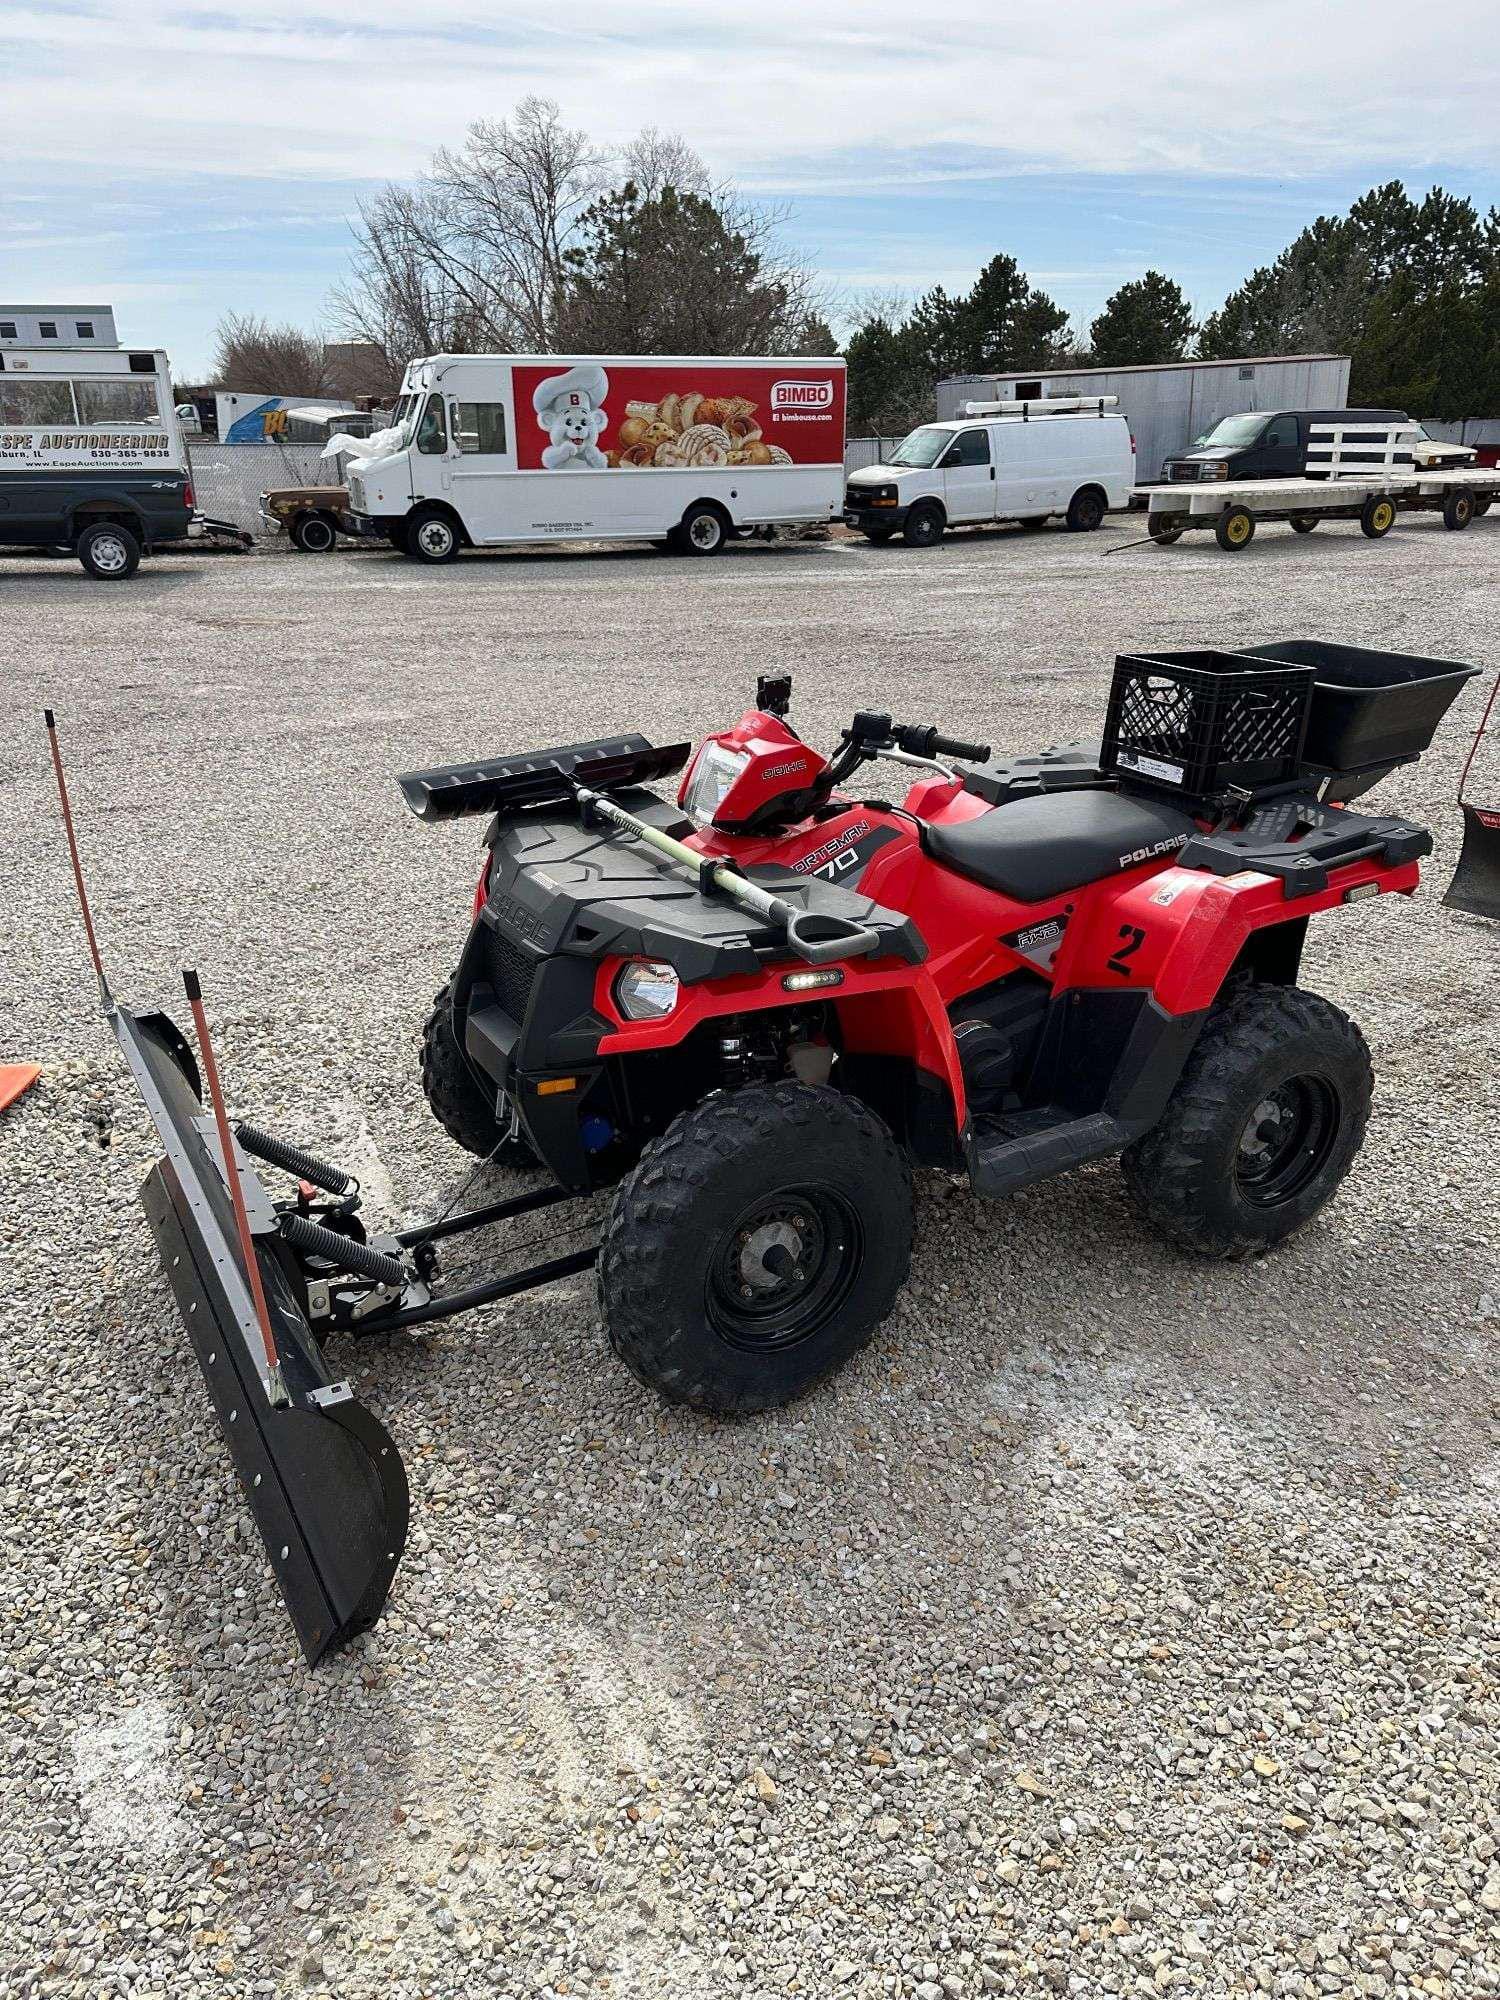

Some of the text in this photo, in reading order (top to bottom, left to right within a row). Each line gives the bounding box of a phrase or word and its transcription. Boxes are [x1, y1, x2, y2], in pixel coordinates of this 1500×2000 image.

[570, 393, 580, 405] B
[776, 387, 828, 402] BIMBO
[781, 413, 833, 421] bimbousa.com
[0, 434, 169, 449] SPE AUCTIONEERING
[1119, 833, 1188, 868] POLARIS
[810, 847, 859, 879] 70
[1018, 925, 1060, 949] AWD
[1106, 924, 1146, 976] 2
